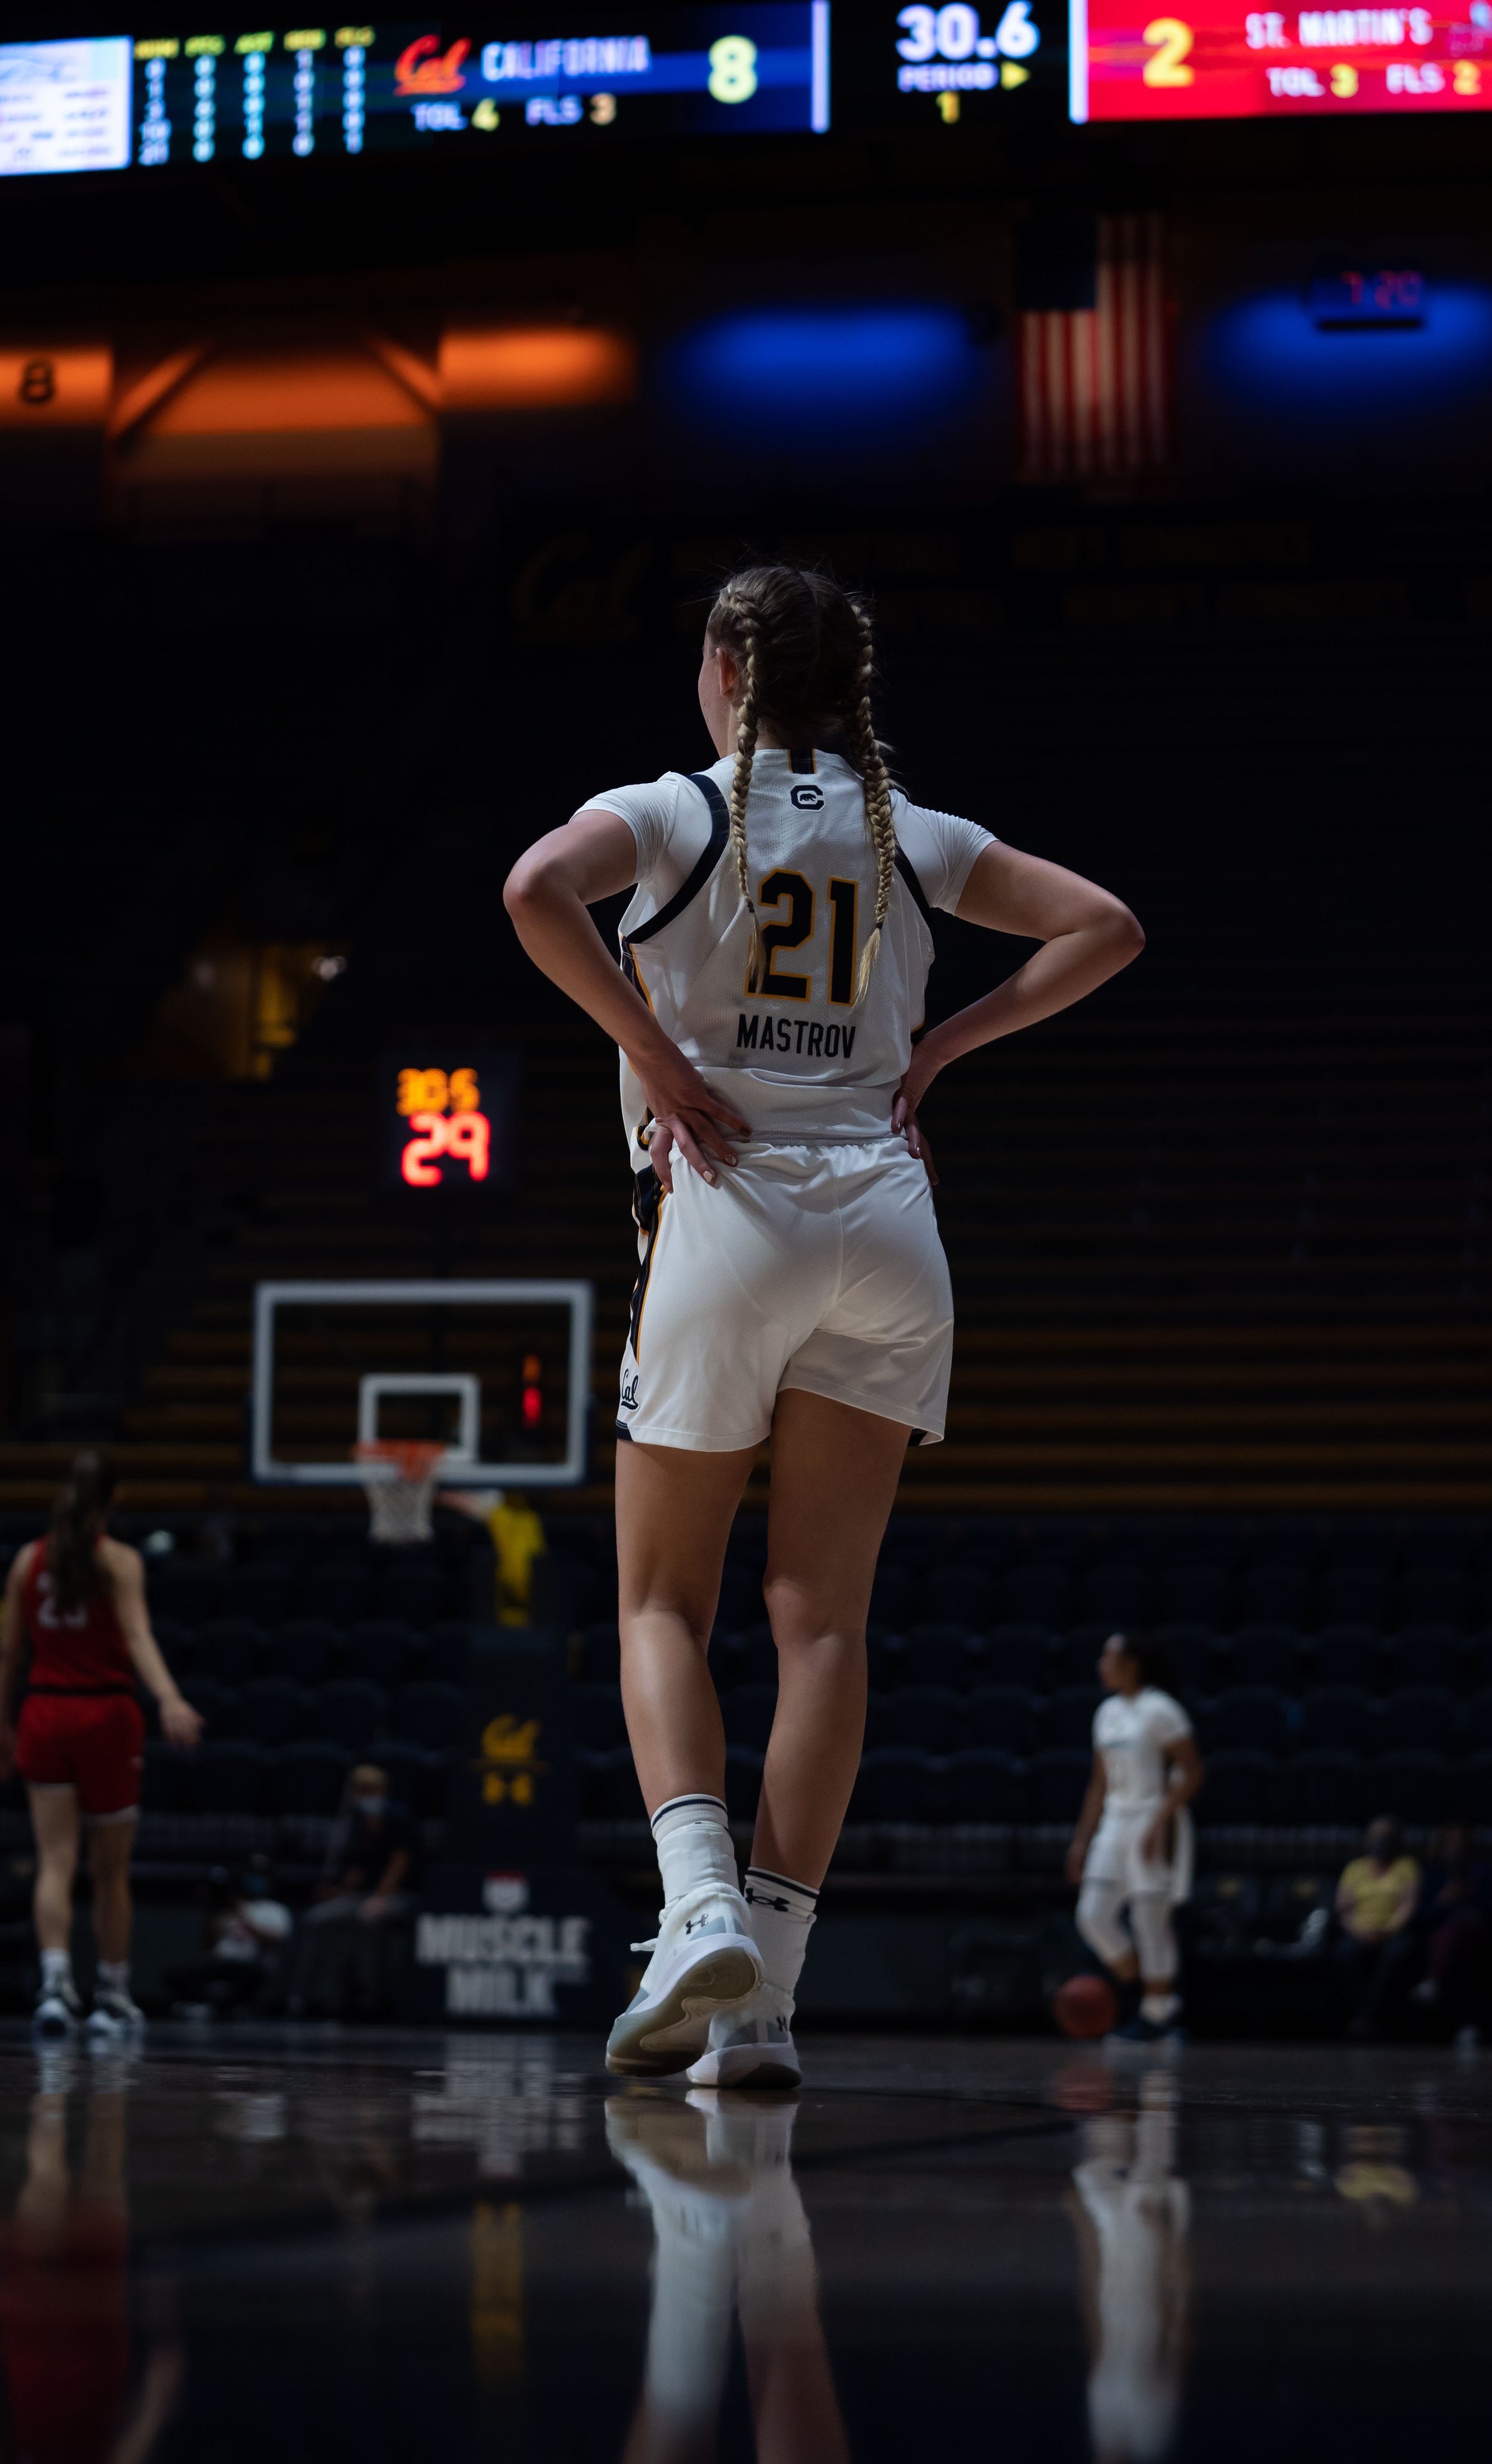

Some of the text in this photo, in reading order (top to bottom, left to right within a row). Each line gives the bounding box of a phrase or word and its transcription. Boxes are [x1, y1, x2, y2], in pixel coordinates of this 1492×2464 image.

[896, 1, 1041, 61] 30.6
[1142, 17, 1194, 88] 2
[1246, 12, 1291, 49] ST.
[394, 35, 471, 97] Cal
[482, 36, 650, 81] CALIFORNIA
[708, 35, 757, 104] 8
[898, 62, 999, 92] PERIOD
[1330, 63, 1358, 98] 3
[1386, 60, 1481, 95] FLS 2
[526, 92, 616, 125] FLS 3
[936, 91, 960, 123] 1
[20, 360, 55, 404] 8
[745, 869, 858, 1006] 21
[736, 1014, 856, 1059] MASTROV
[402, 1111, 491, 1187] 29
[621, 1369, 639, 1410] Cal
[416, 1913, 592, 1965] MUSCLE
[445, 1969, 559, 2018] MILK
